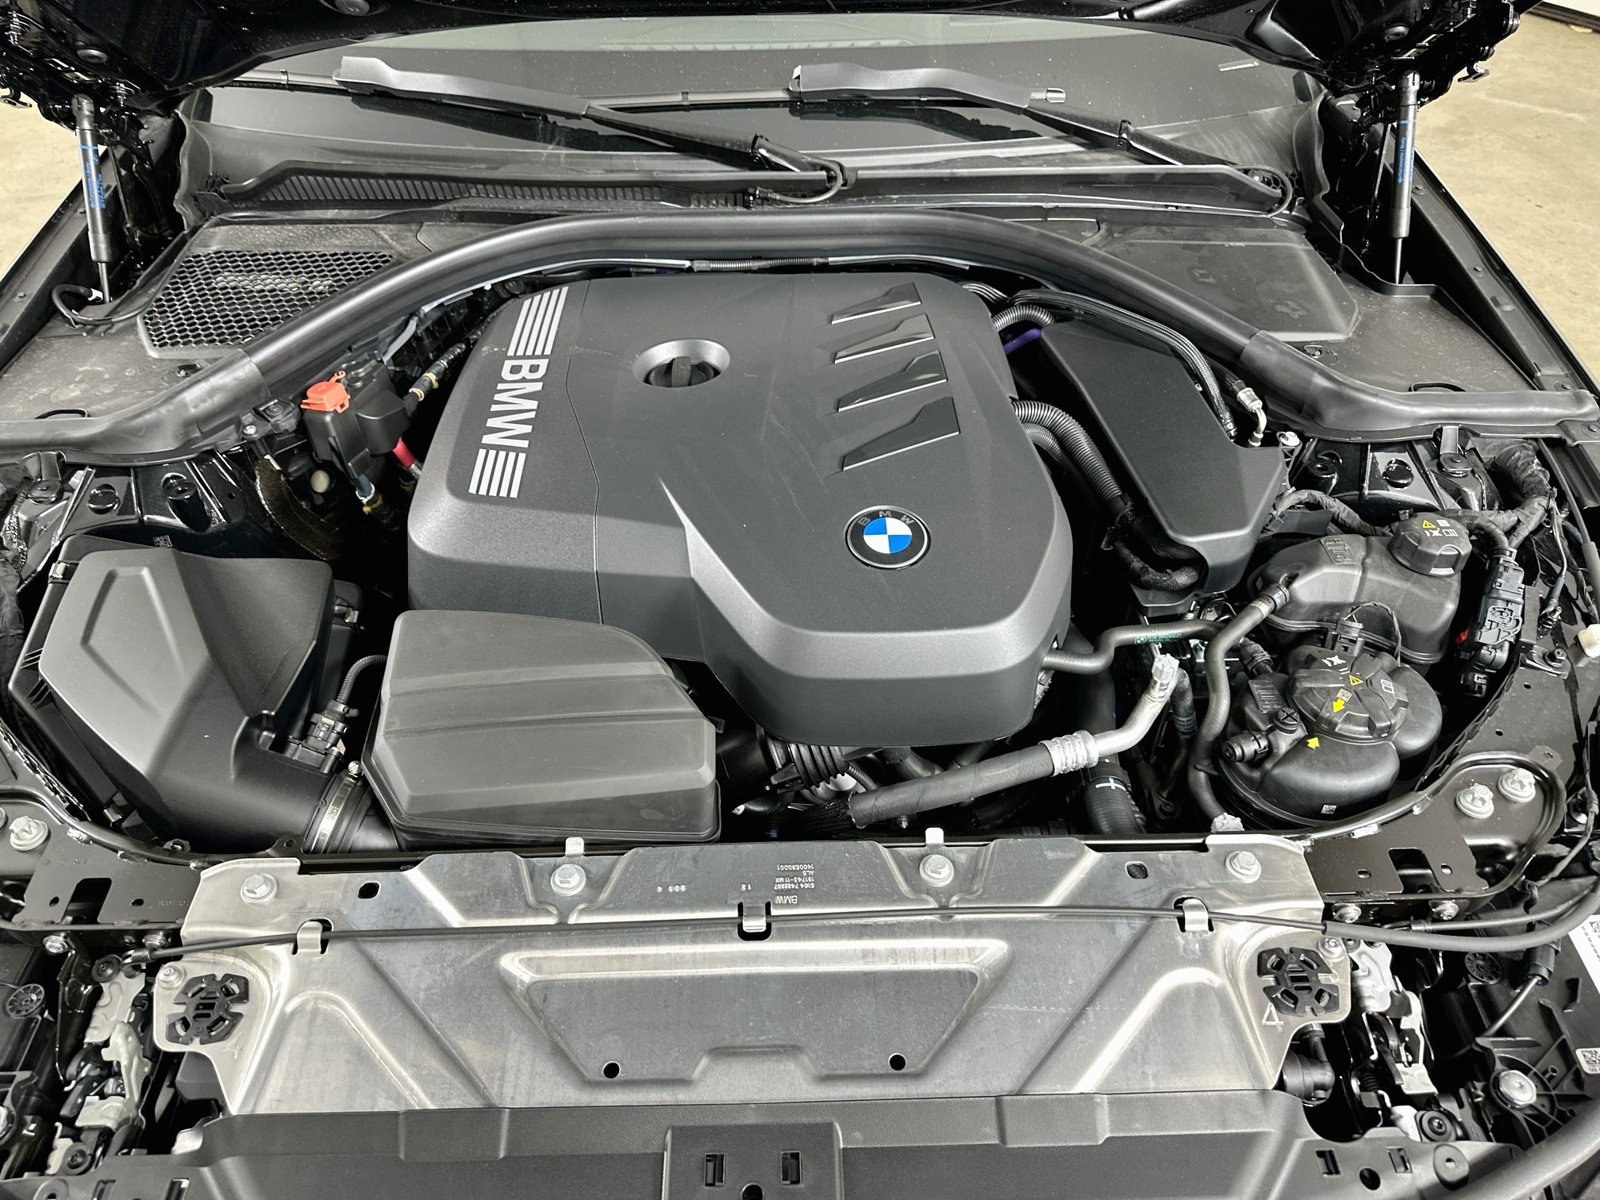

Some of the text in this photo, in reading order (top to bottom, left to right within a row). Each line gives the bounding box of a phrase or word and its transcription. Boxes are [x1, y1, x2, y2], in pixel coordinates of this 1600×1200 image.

[481, 358, 549, 448] BMW
[858, 511, 914, 526] BMW
[775, 895, 797, 904] BMW
